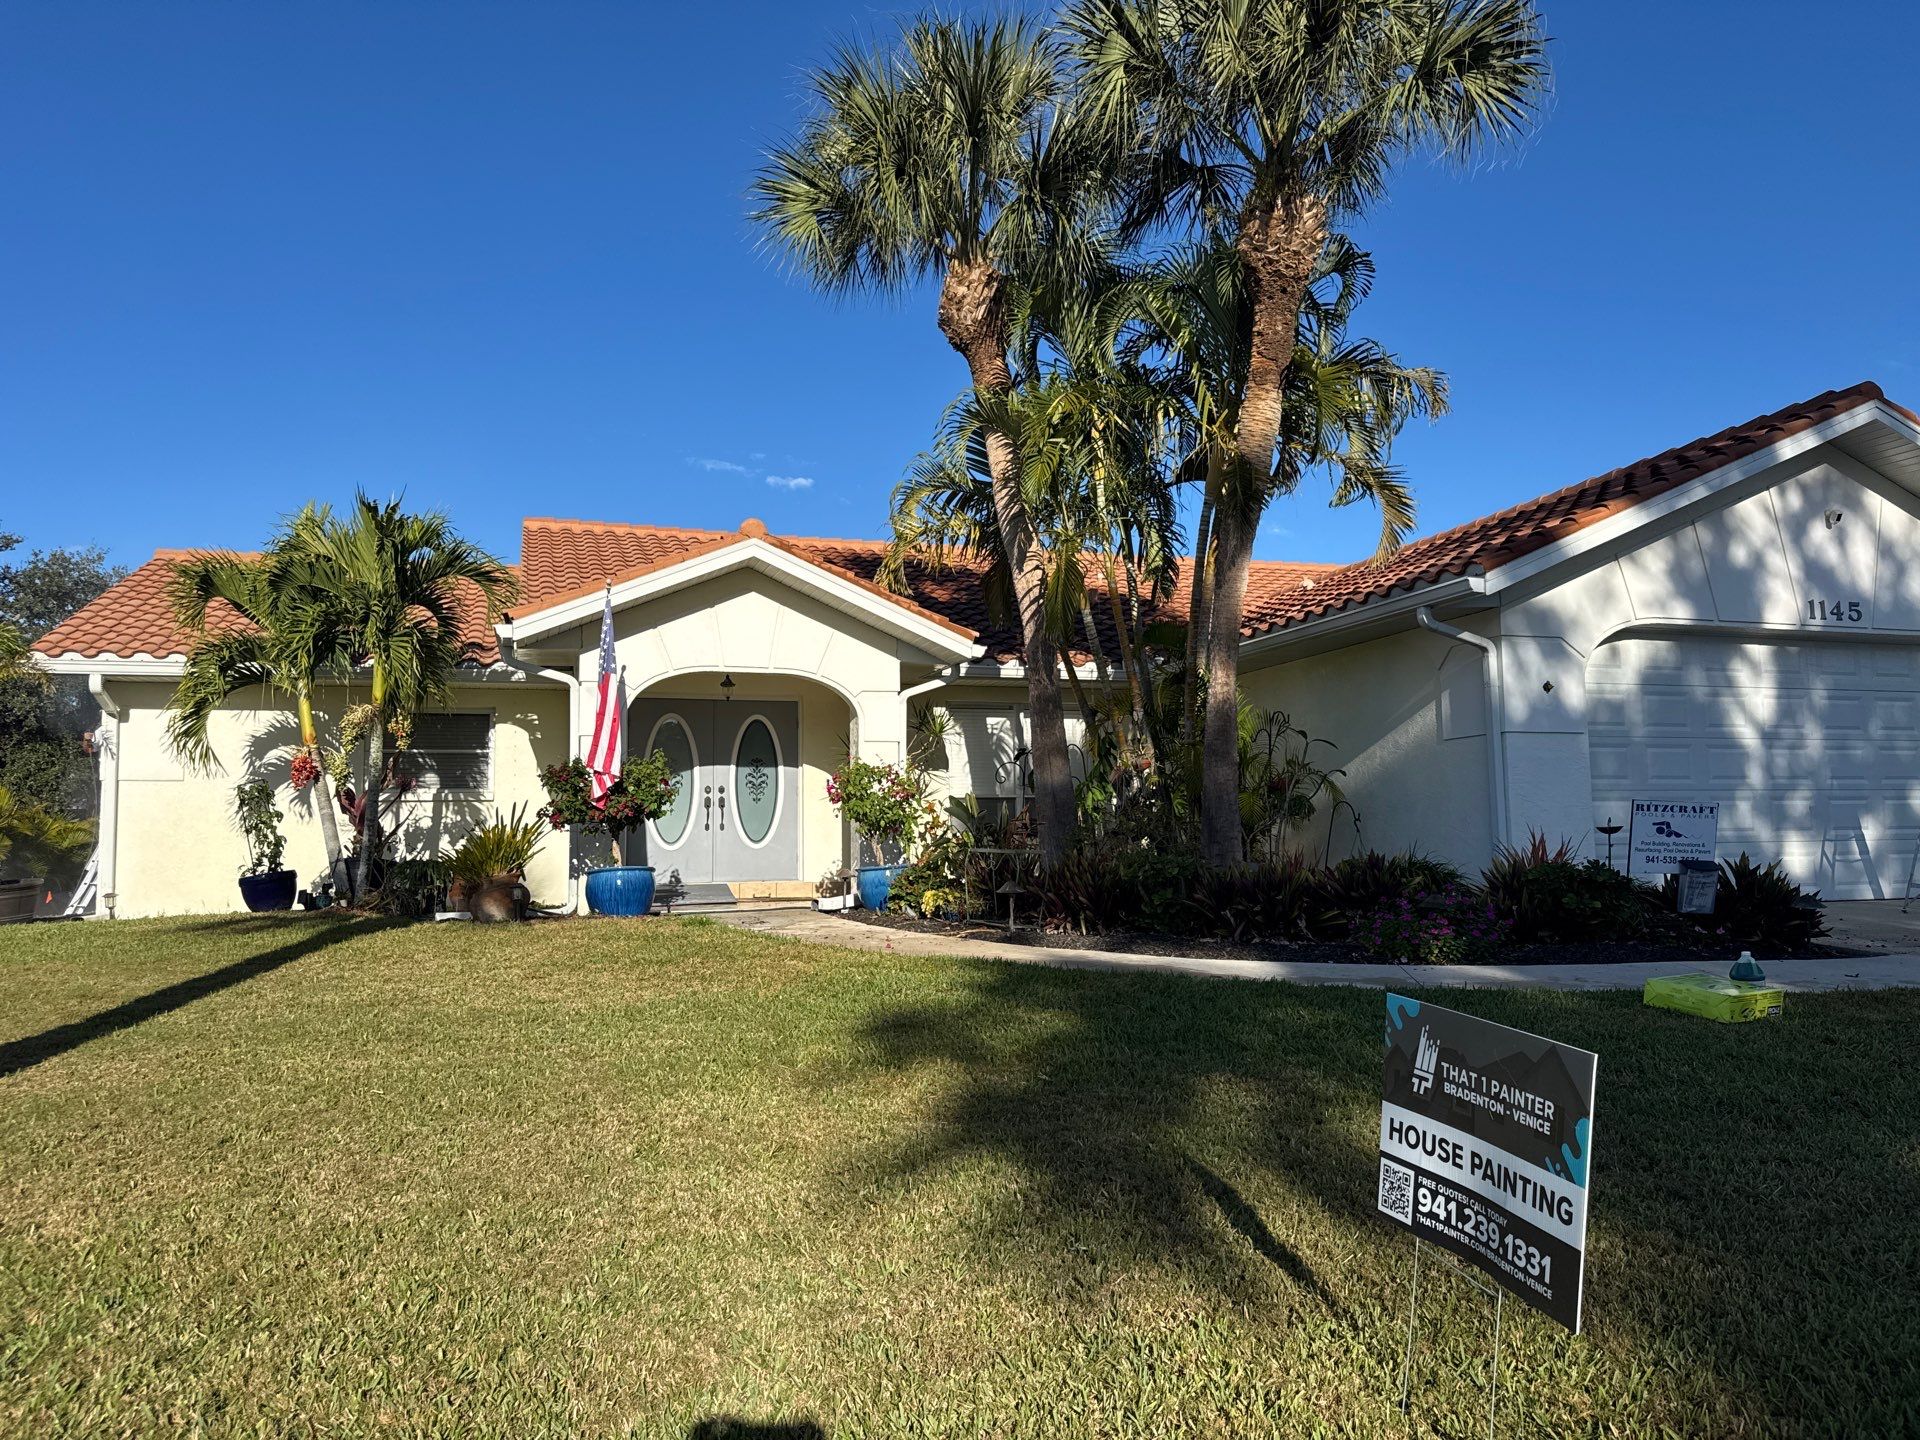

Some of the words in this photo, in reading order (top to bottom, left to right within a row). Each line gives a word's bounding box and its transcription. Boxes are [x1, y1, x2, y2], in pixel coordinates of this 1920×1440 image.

[1808, 599, 1863, 622] 1145
[1635, 803, 1717, 815] RITZCRAFT
[1441, 1061, 1478, 1089] THAT
[1481, 1076, 1487, 1093] 1
[1491, 1080, 1555, 1120] PAINTER
[1444, 1081, 1504, 1116] BRADENTON
[1512, 1108, 1551, 1135] VENICE
[1388, 1117, 1464, 1170] HOUSE
[1470, 1151, 1574, 1226] PAINTING
[1418, 1175, 1437, 1193] FREE
[1437, 1184, 1469, 1205] QUOTES!
[1470, 1199, 1485, 1215] CALL
[1487, 1208, 1508, 1226] TODAY
[1416, 1213, 1553, 1300] THAT1PAINTER.COM/BRADENTON-VENICE
[1417, 1187, 1552, 1285] 941.239.1331
